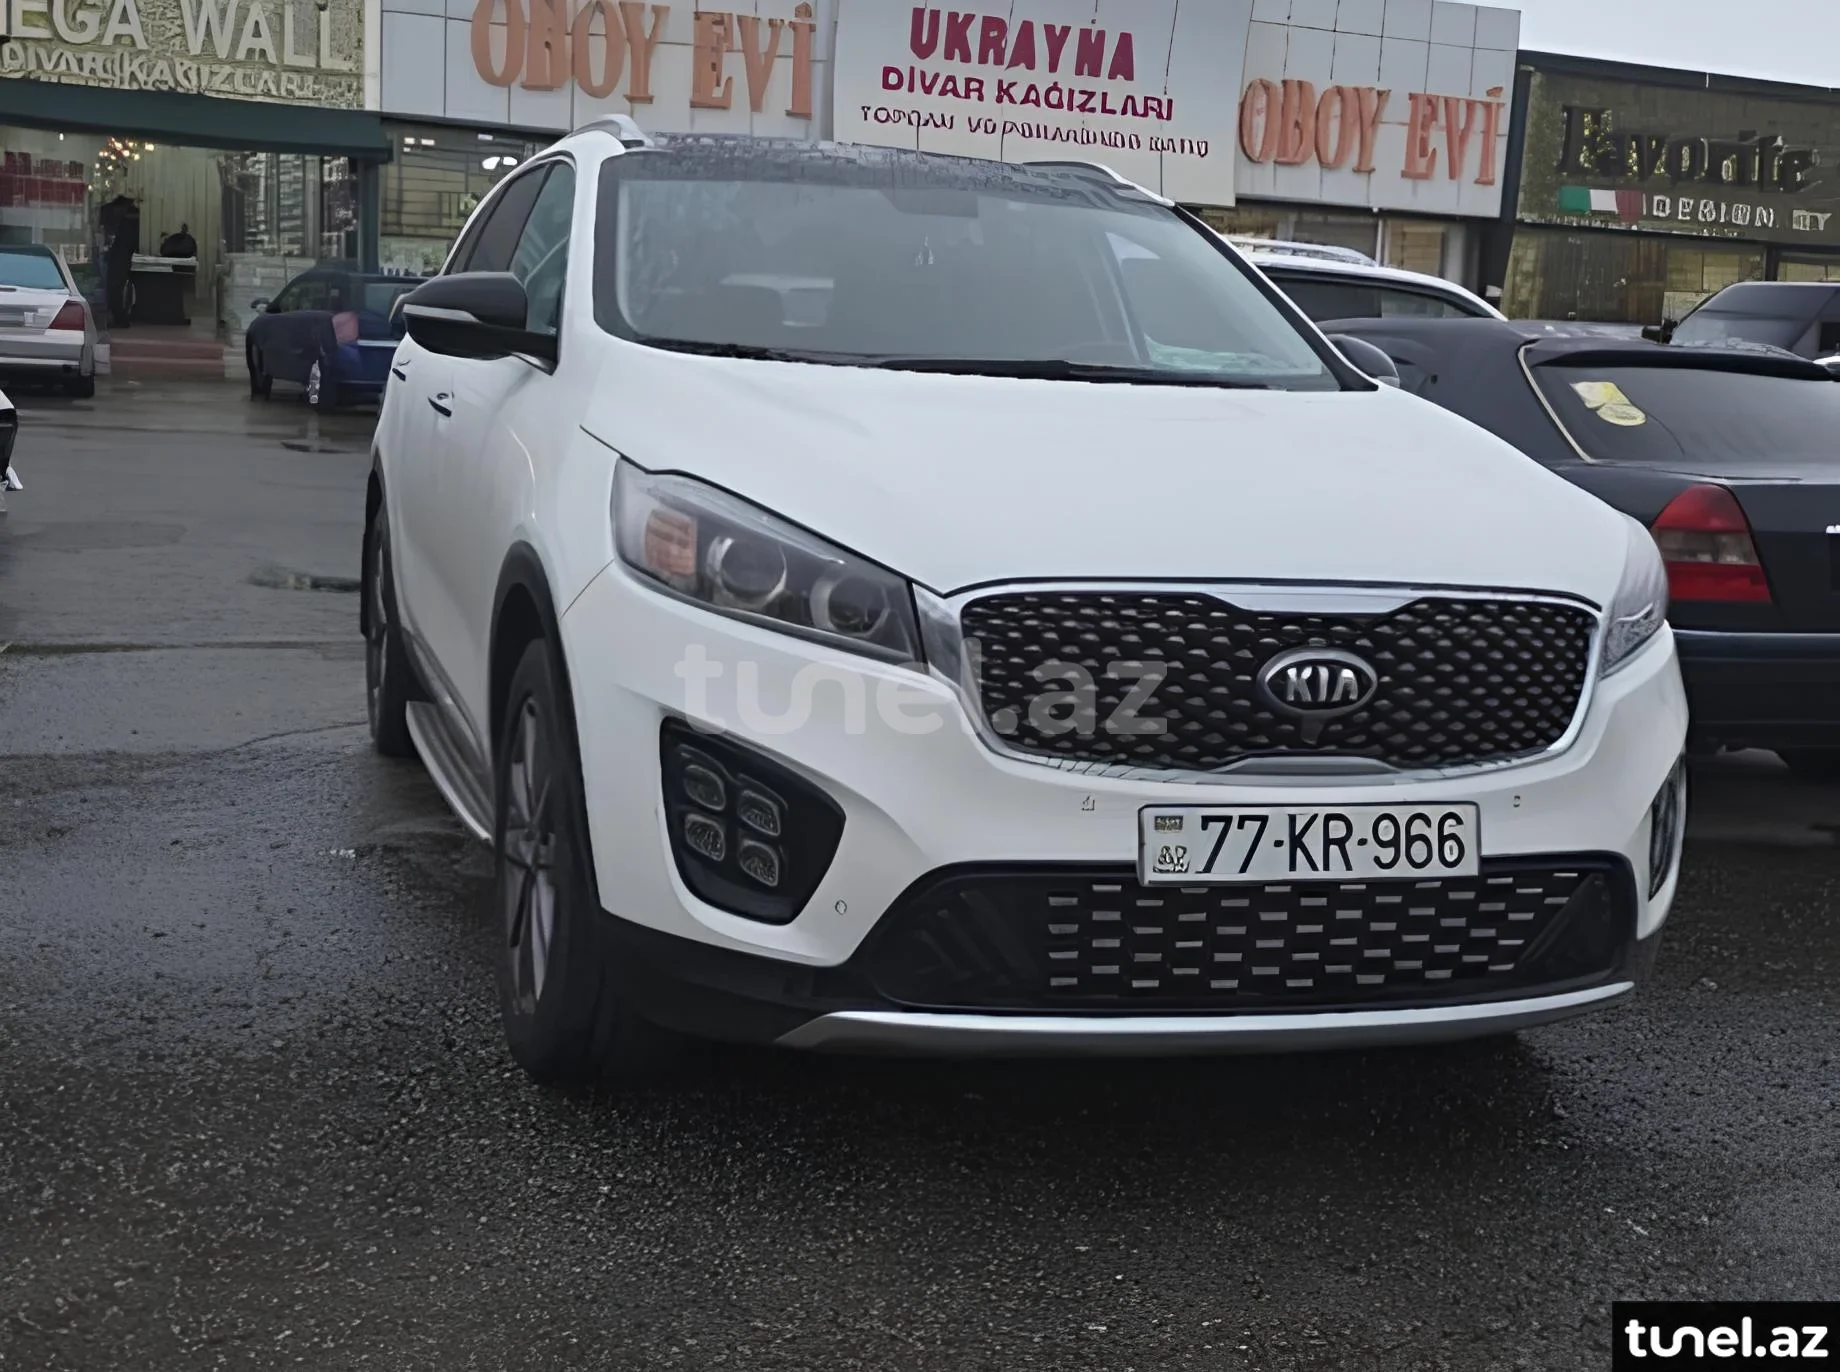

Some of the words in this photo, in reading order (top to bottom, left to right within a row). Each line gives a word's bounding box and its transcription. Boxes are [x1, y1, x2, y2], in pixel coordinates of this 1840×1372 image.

[181, 0, 356, 71] WALL
[471, 0, 670, 104] OBOY
[910, 7, 1136, 82] UKRAYNA
[1239, 78, 1391, 173] OBOY
[1286, 665, 1359, 702] KIA
[1195, 811, 1466, 874] 77-KR-966
